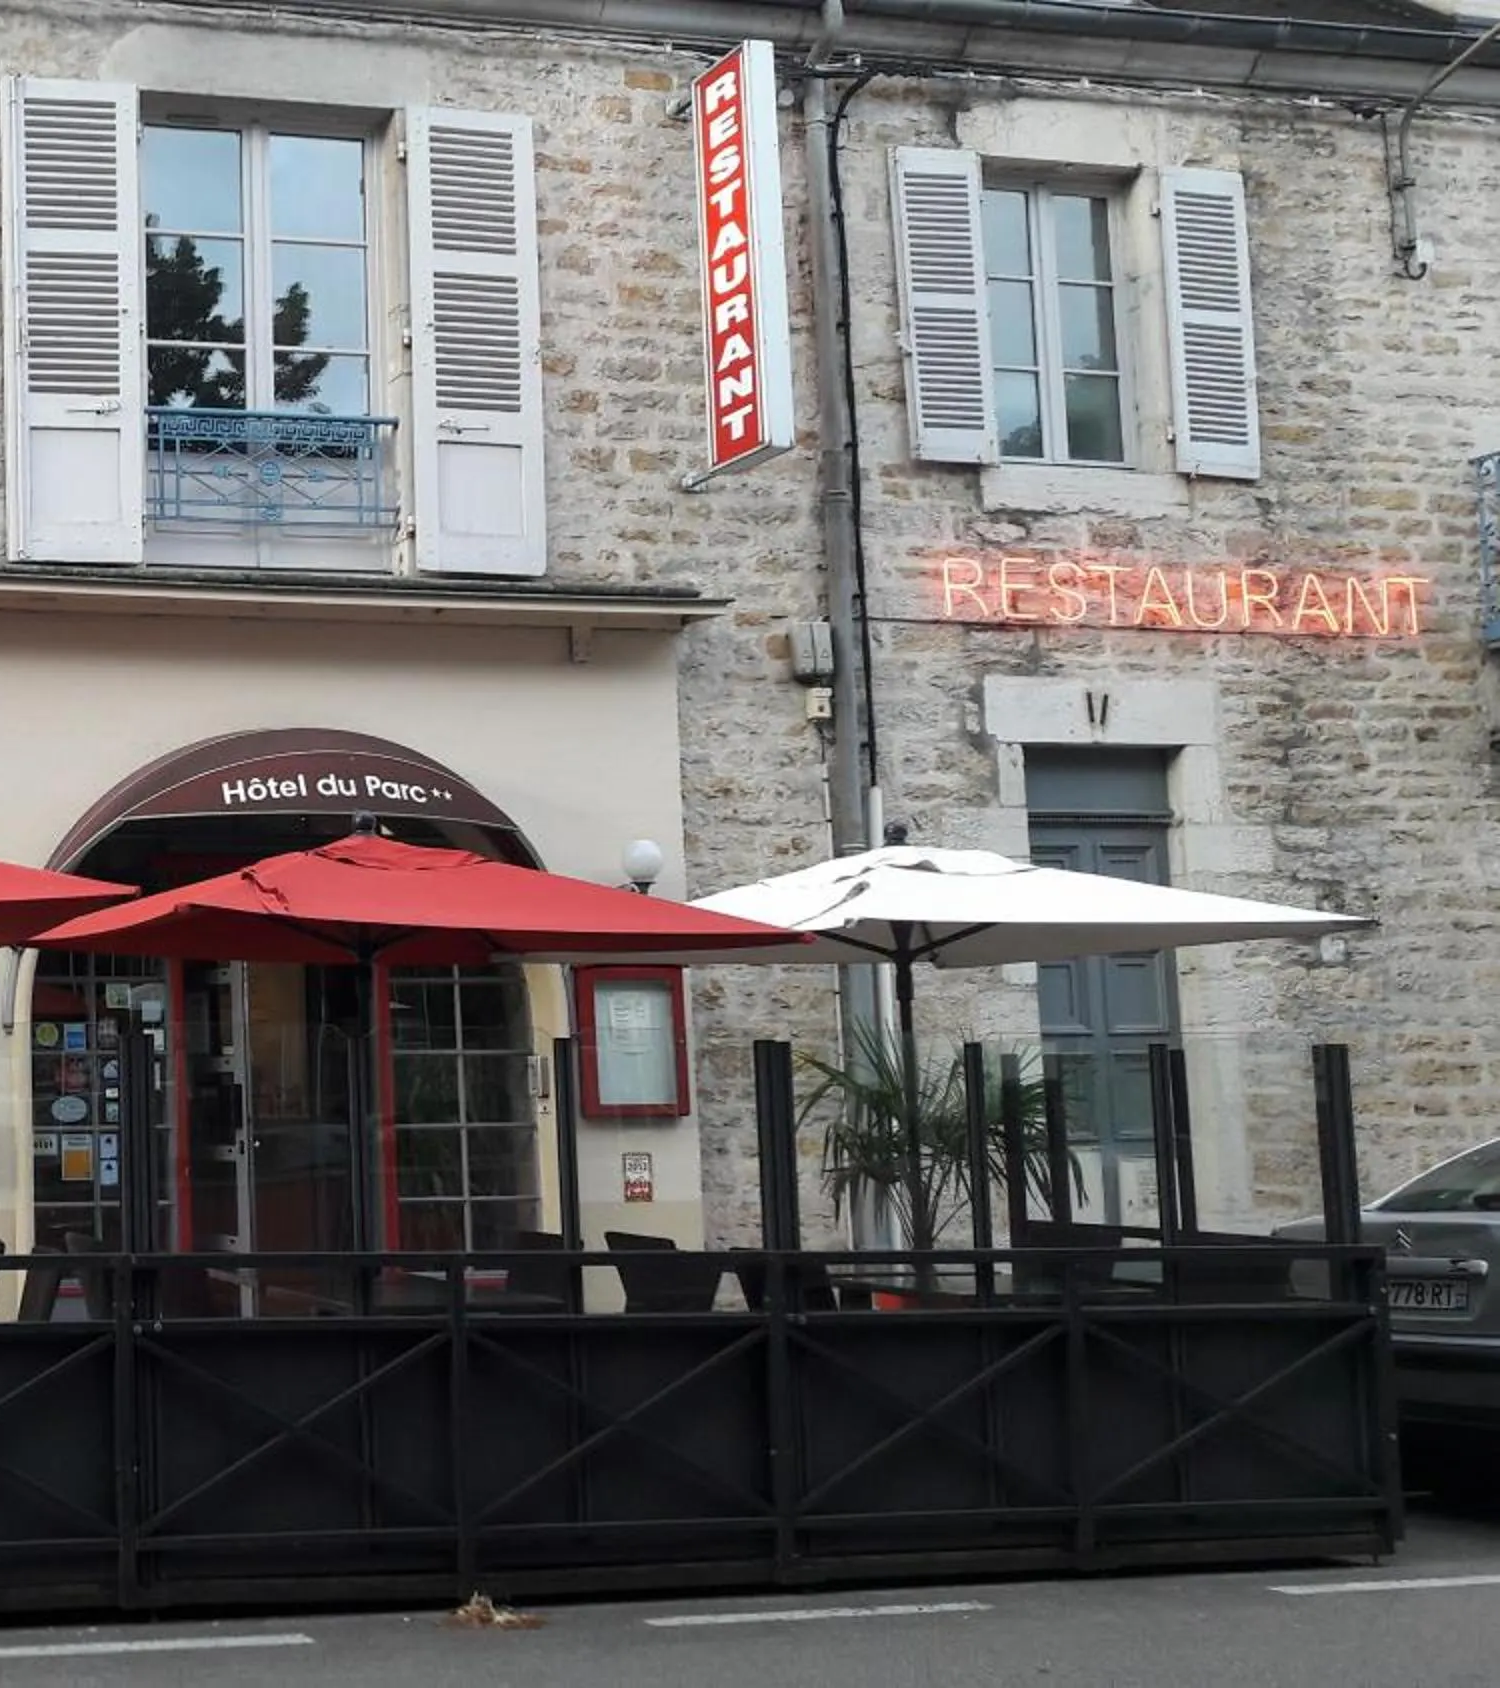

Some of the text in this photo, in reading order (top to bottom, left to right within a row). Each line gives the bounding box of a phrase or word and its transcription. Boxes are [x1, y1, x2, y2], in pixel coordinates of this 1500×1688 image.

[705, 70, 753, 442] RESTAURANT
[941, 557, 1430, 636] RESTAURANT
[221, 773, 428, 805] Hôtel du Parc
